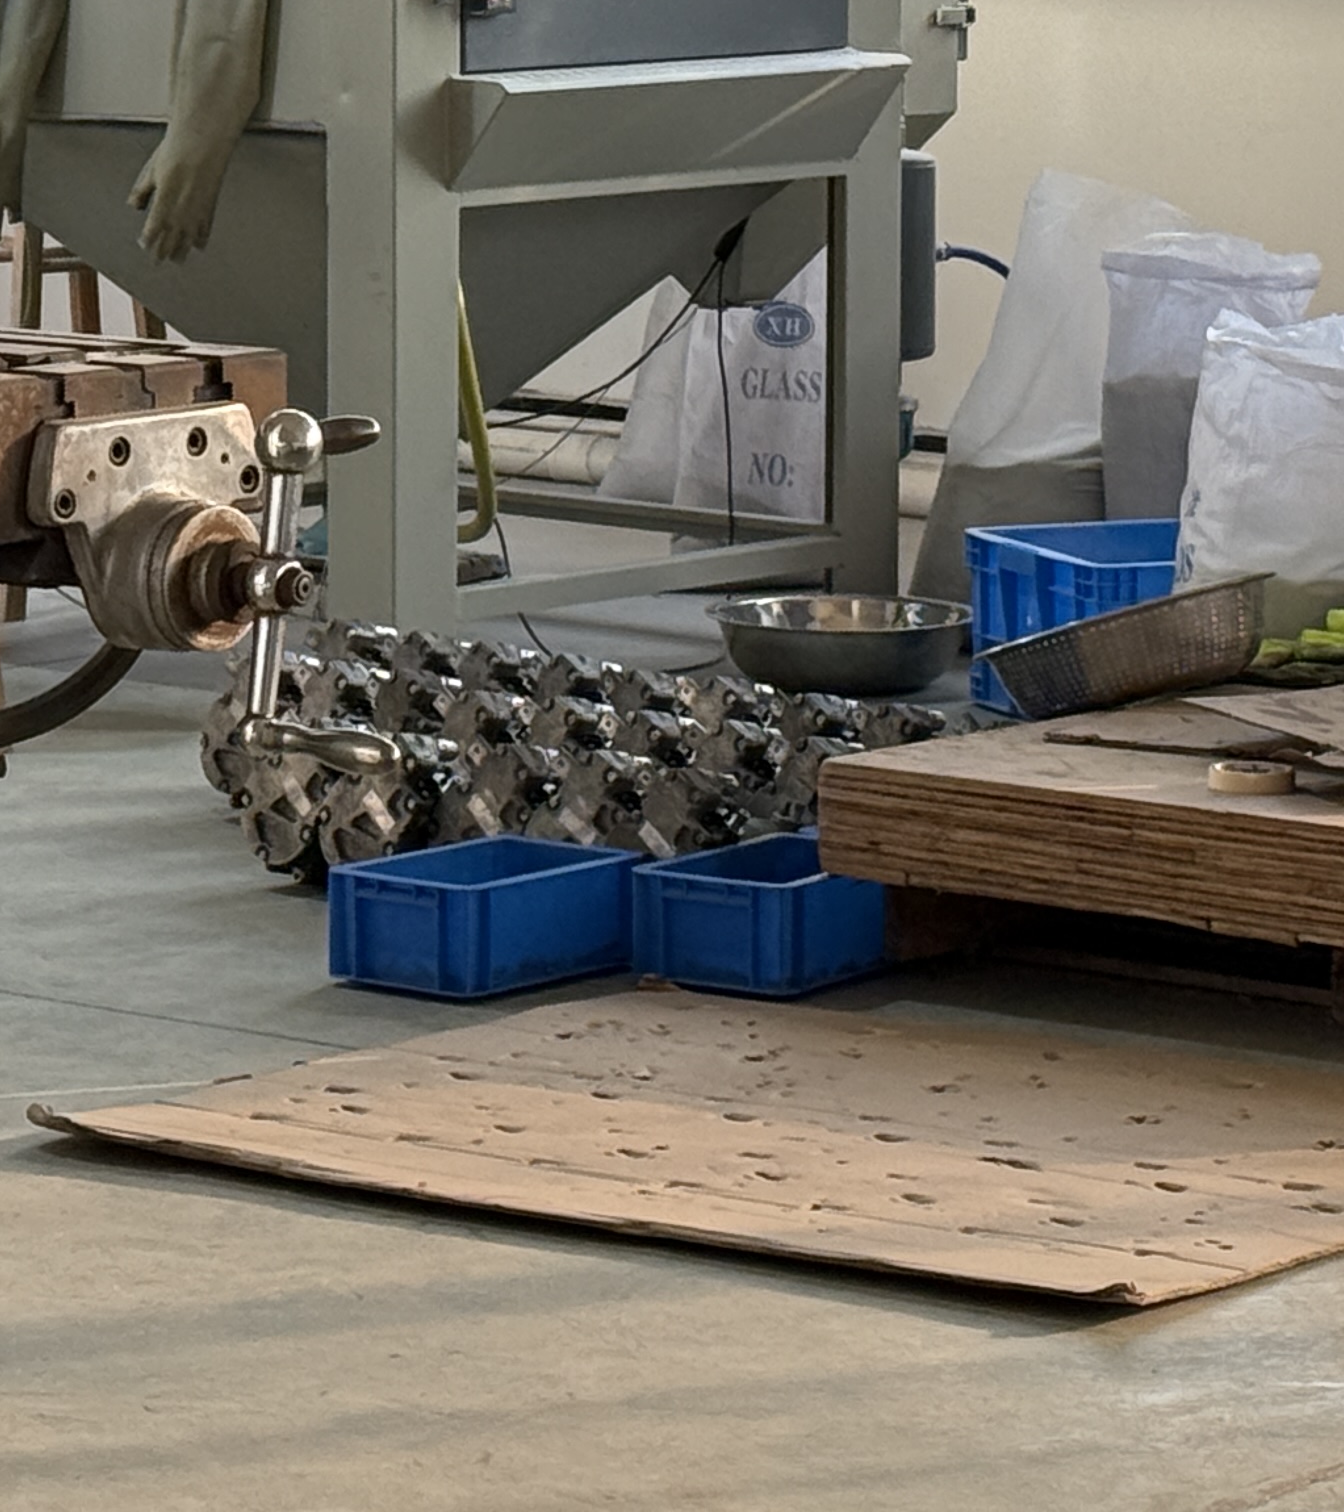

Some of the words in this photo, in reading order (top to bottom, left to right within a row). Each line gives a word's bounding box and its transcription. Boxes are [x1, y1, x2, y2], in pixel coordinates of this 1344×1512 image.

[767, 316, 803, 337] XH
[740, 366, 823, 403] GLASS
[747, 452, 795, 488] NO:
